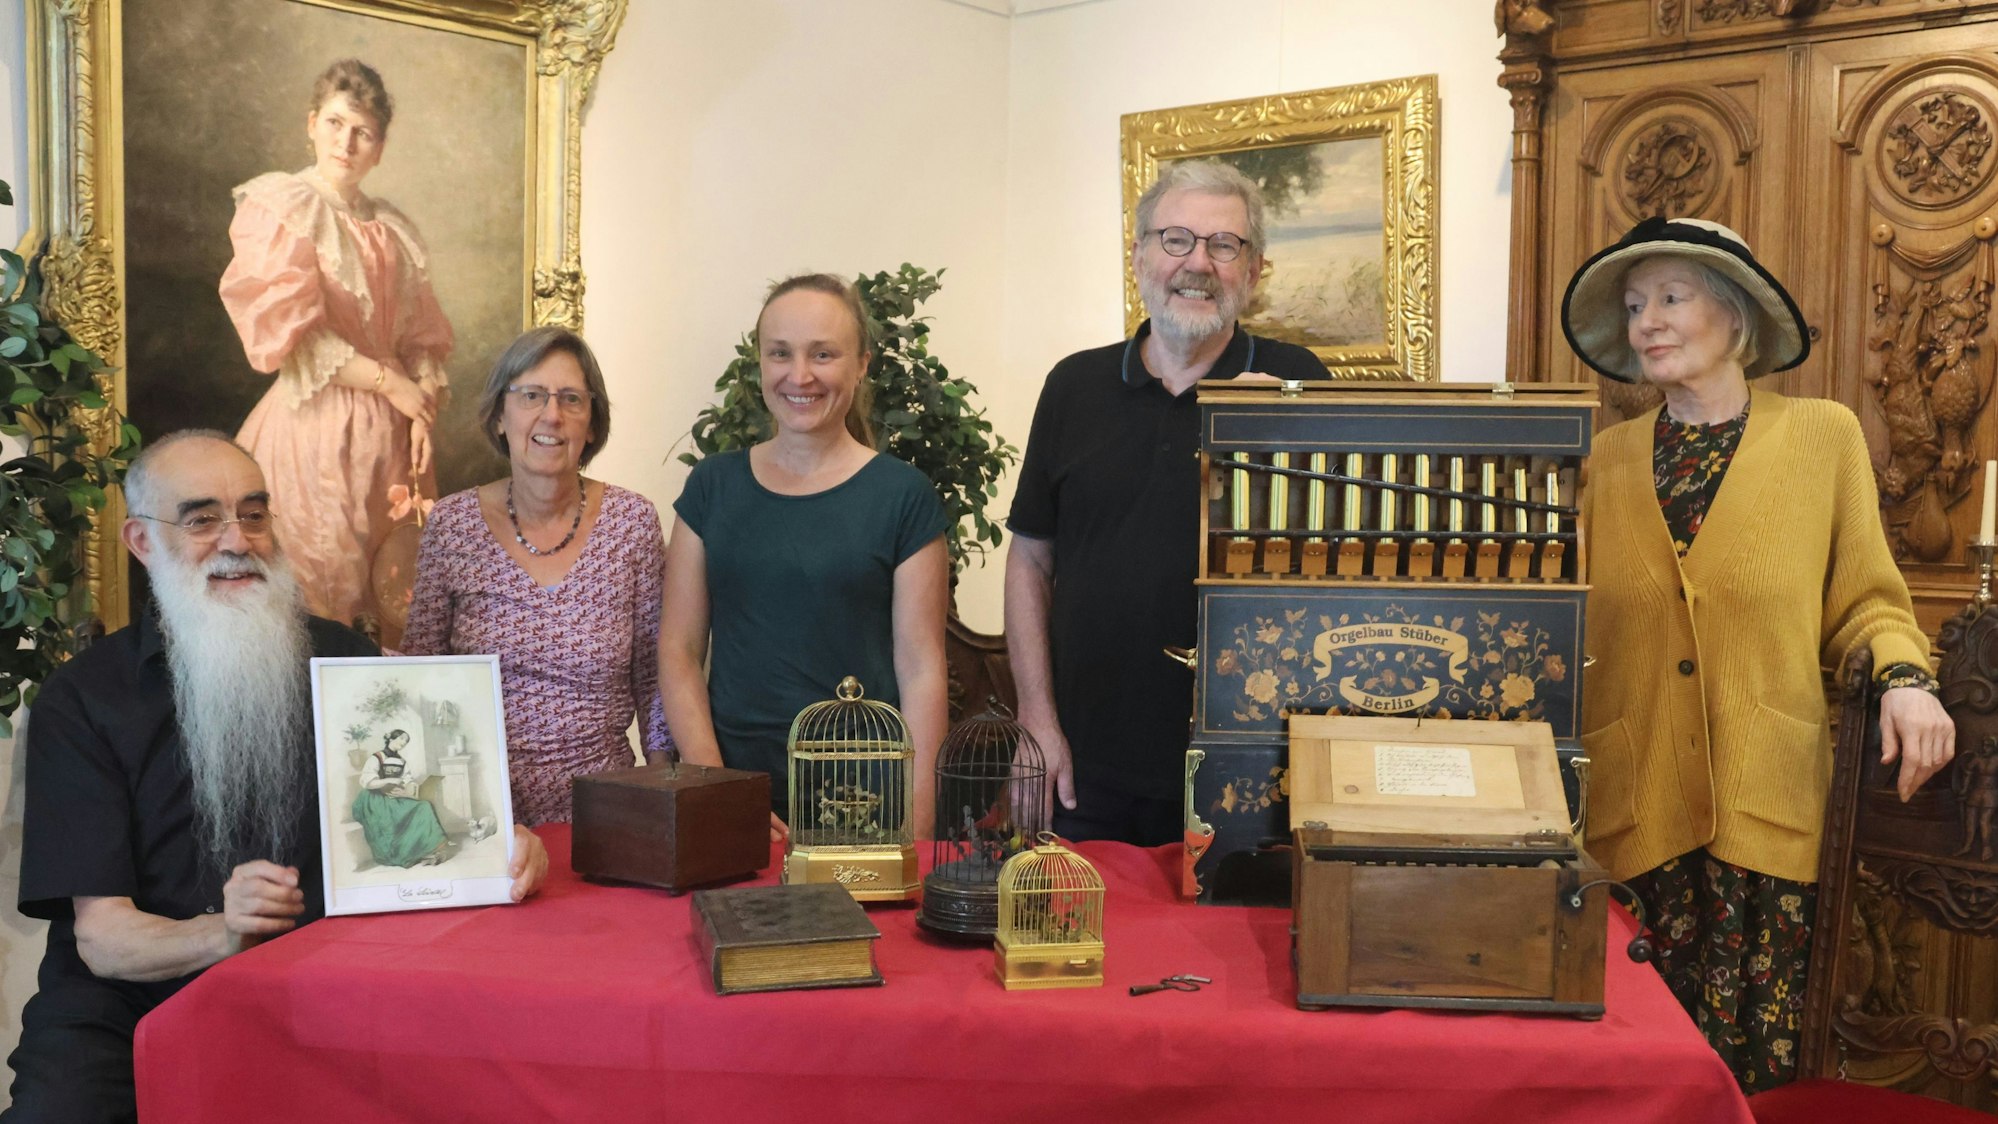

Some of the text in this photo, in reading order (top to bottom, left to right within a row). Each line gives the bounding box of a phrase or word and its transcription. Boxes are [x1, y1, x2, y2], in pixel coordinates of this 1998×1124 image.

[1330, 627, 1448, 645] Orgelbau Stüber
[1362, 696, 1414, 710] Berlin
